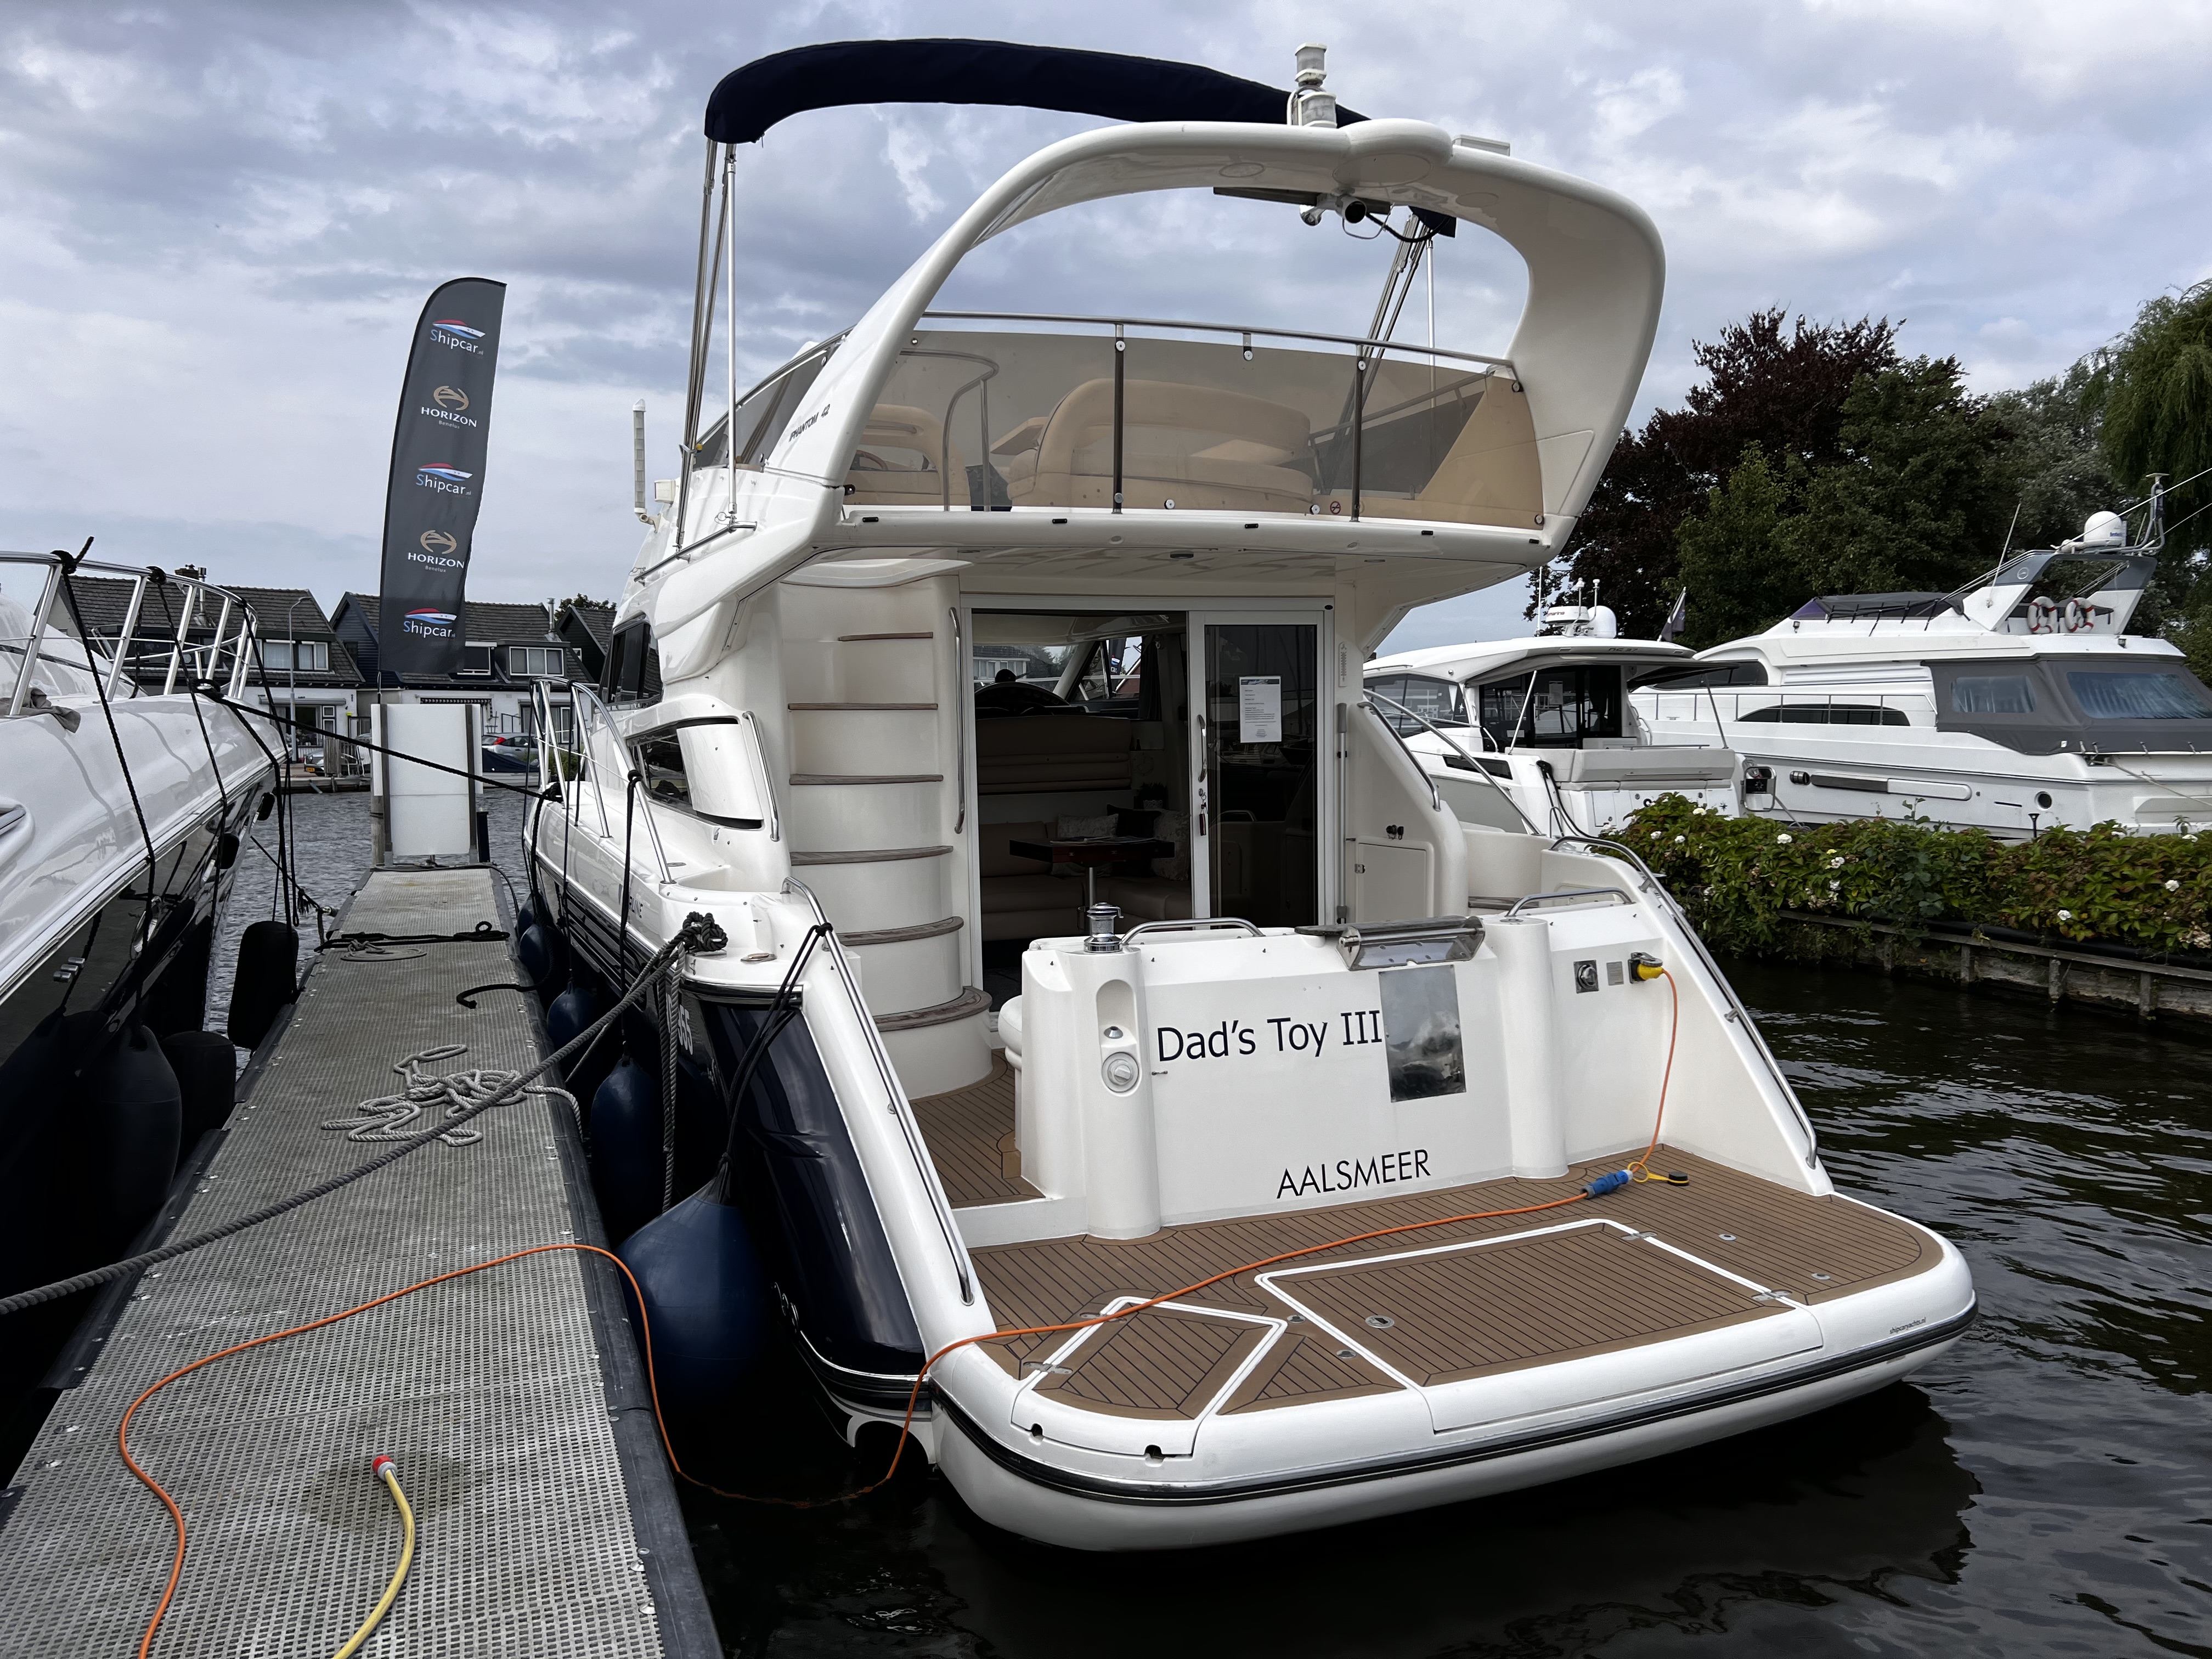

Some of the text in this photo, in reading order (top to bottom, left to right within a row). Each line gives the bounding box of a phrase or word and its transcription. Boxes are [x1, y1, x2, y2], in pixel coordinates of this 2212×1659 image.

[421, 406, 477, 428] HORIZON
[438, 420, 460, 430] Benelux
[788, 411, 819, 442] PHANTOM
[408, 552, 465, 569] HORIZON
[1157, 1009, 1383, 1062] Dad's Toy III
[1276, 1149, 1431, 1199] AALSMEER
